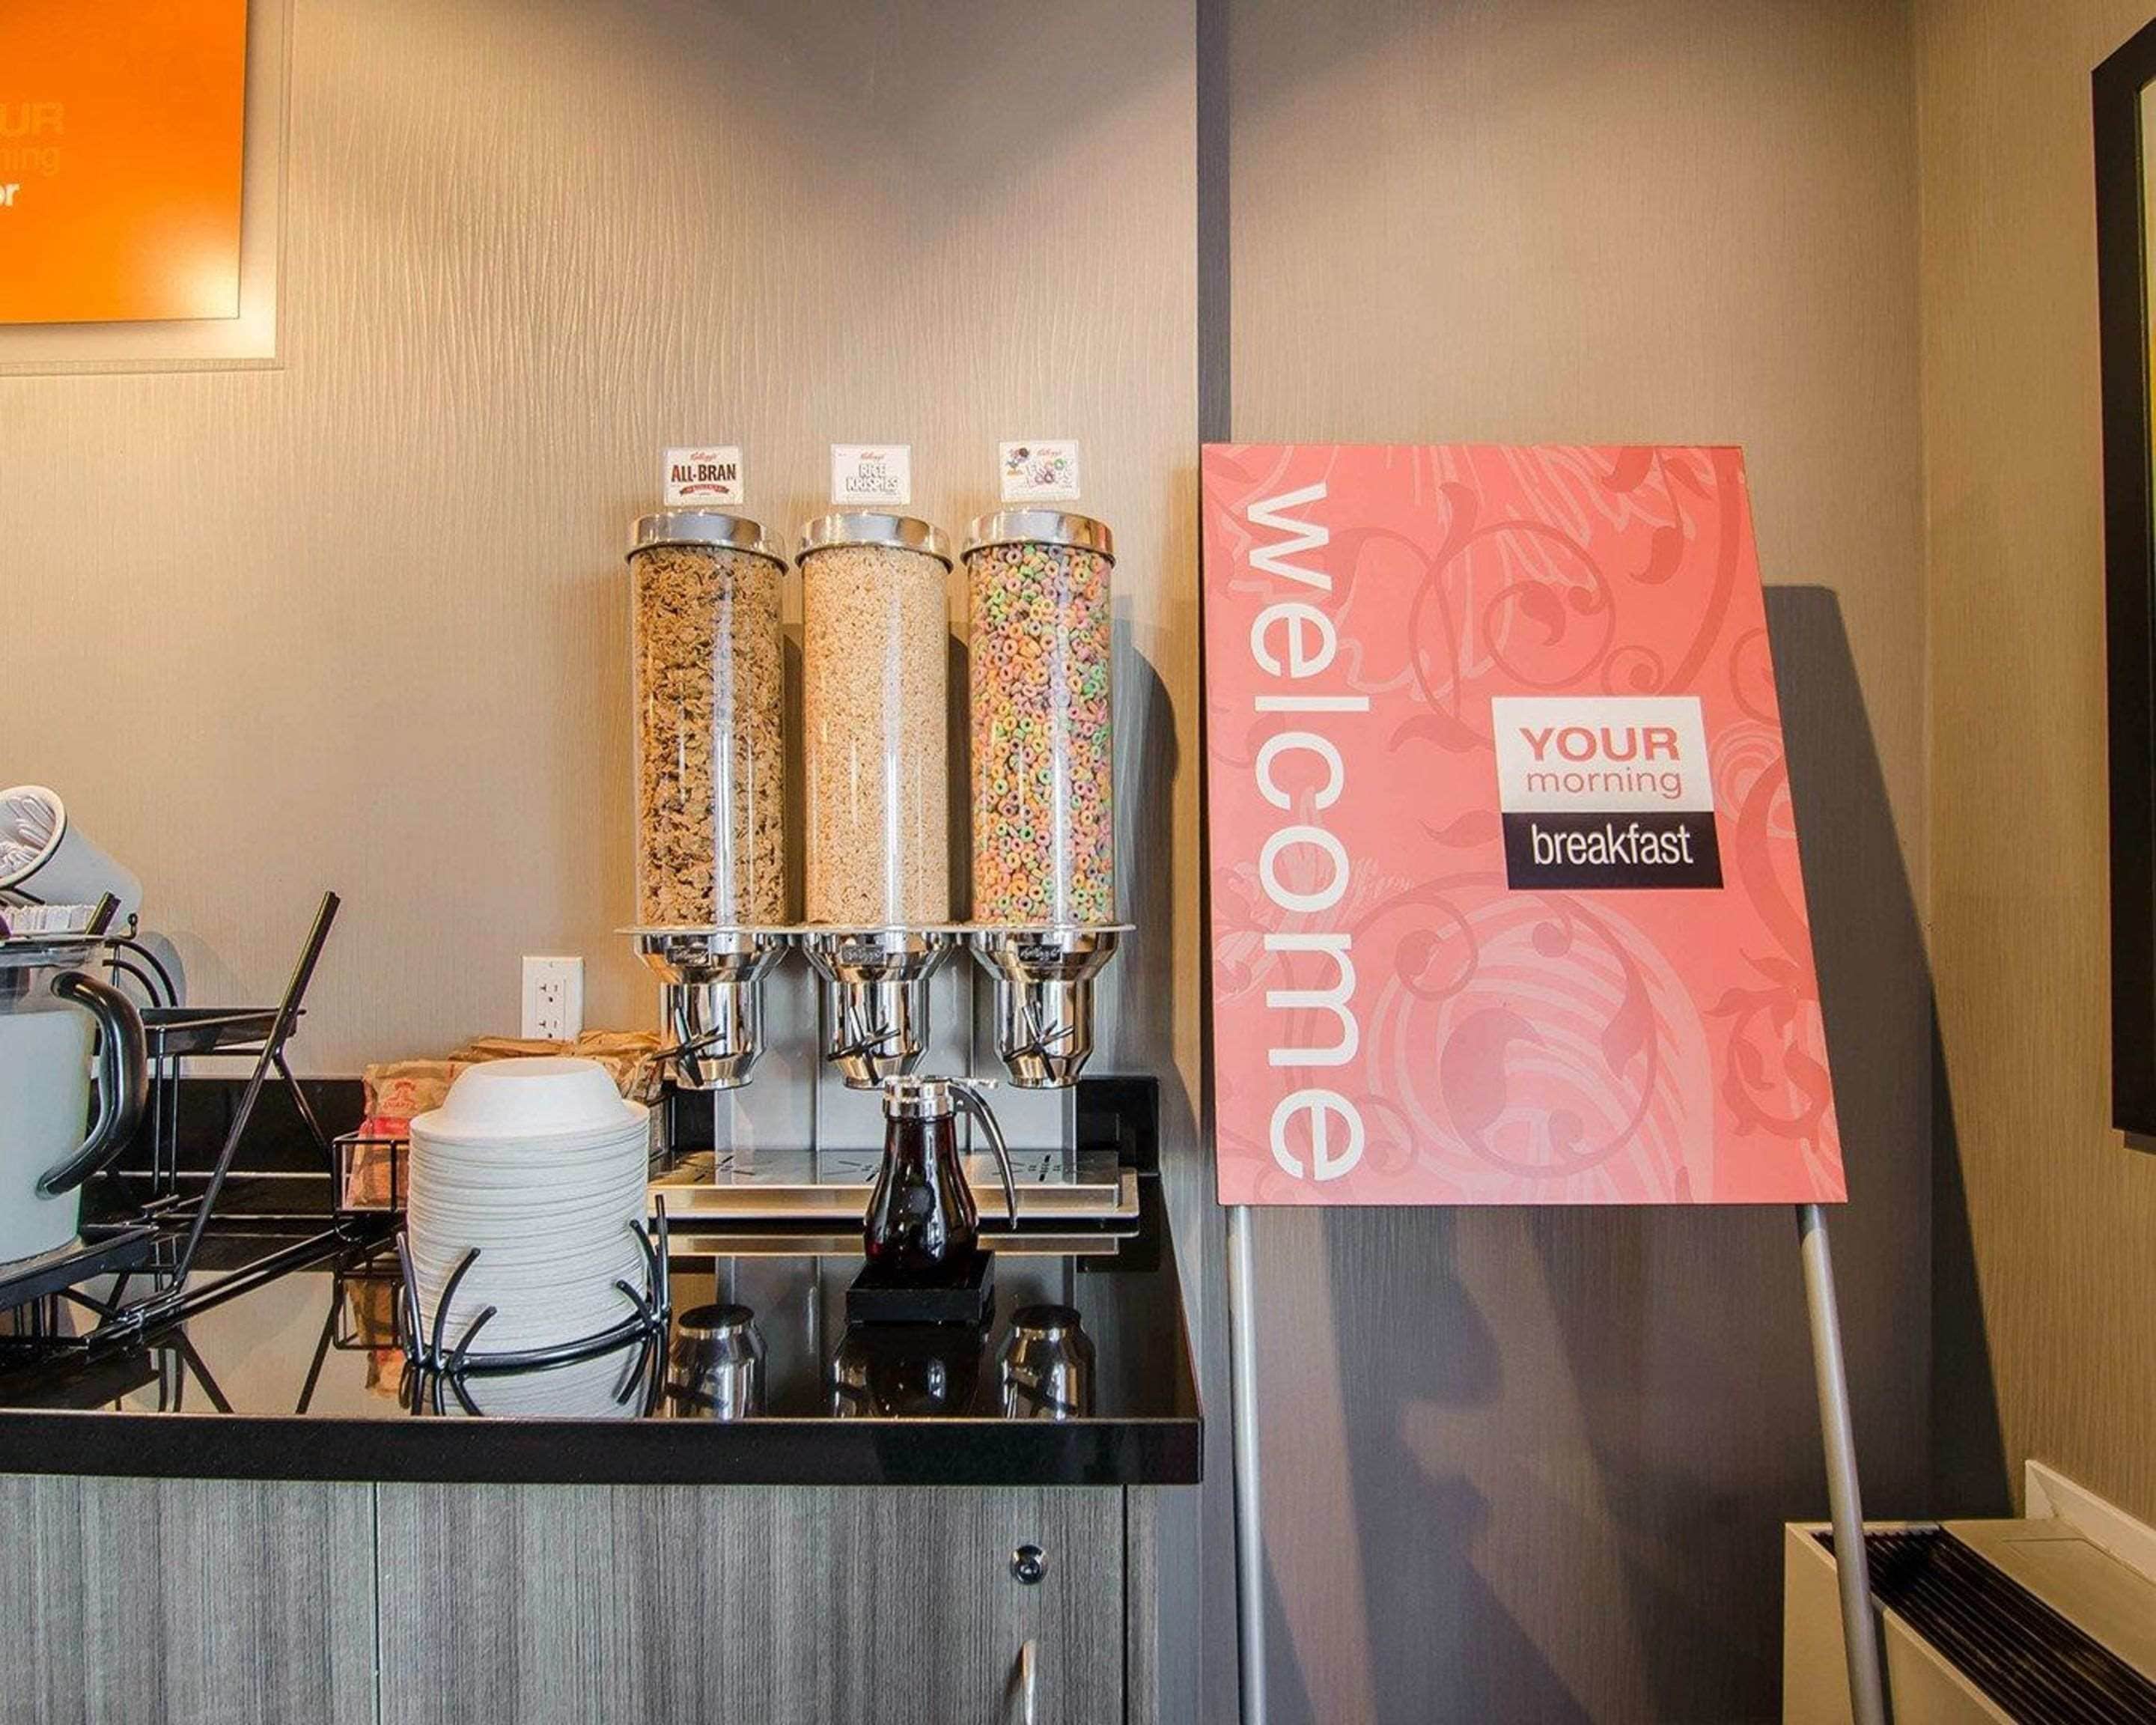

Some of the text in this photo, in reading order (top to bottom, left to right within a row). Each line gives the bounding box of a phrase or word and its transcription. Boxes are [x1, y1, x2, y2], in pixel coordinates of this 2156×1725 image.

[845, 476, 899, 493] KRISPIES
[858, 463, 886, 478] RICE
[1519, 726, 1681, 762] YOUR
[1526, 767, 1682, 800] morning
[1246, 483, 1371, 1181] welcome
[1531, 823, 1694, 865] breakfast
